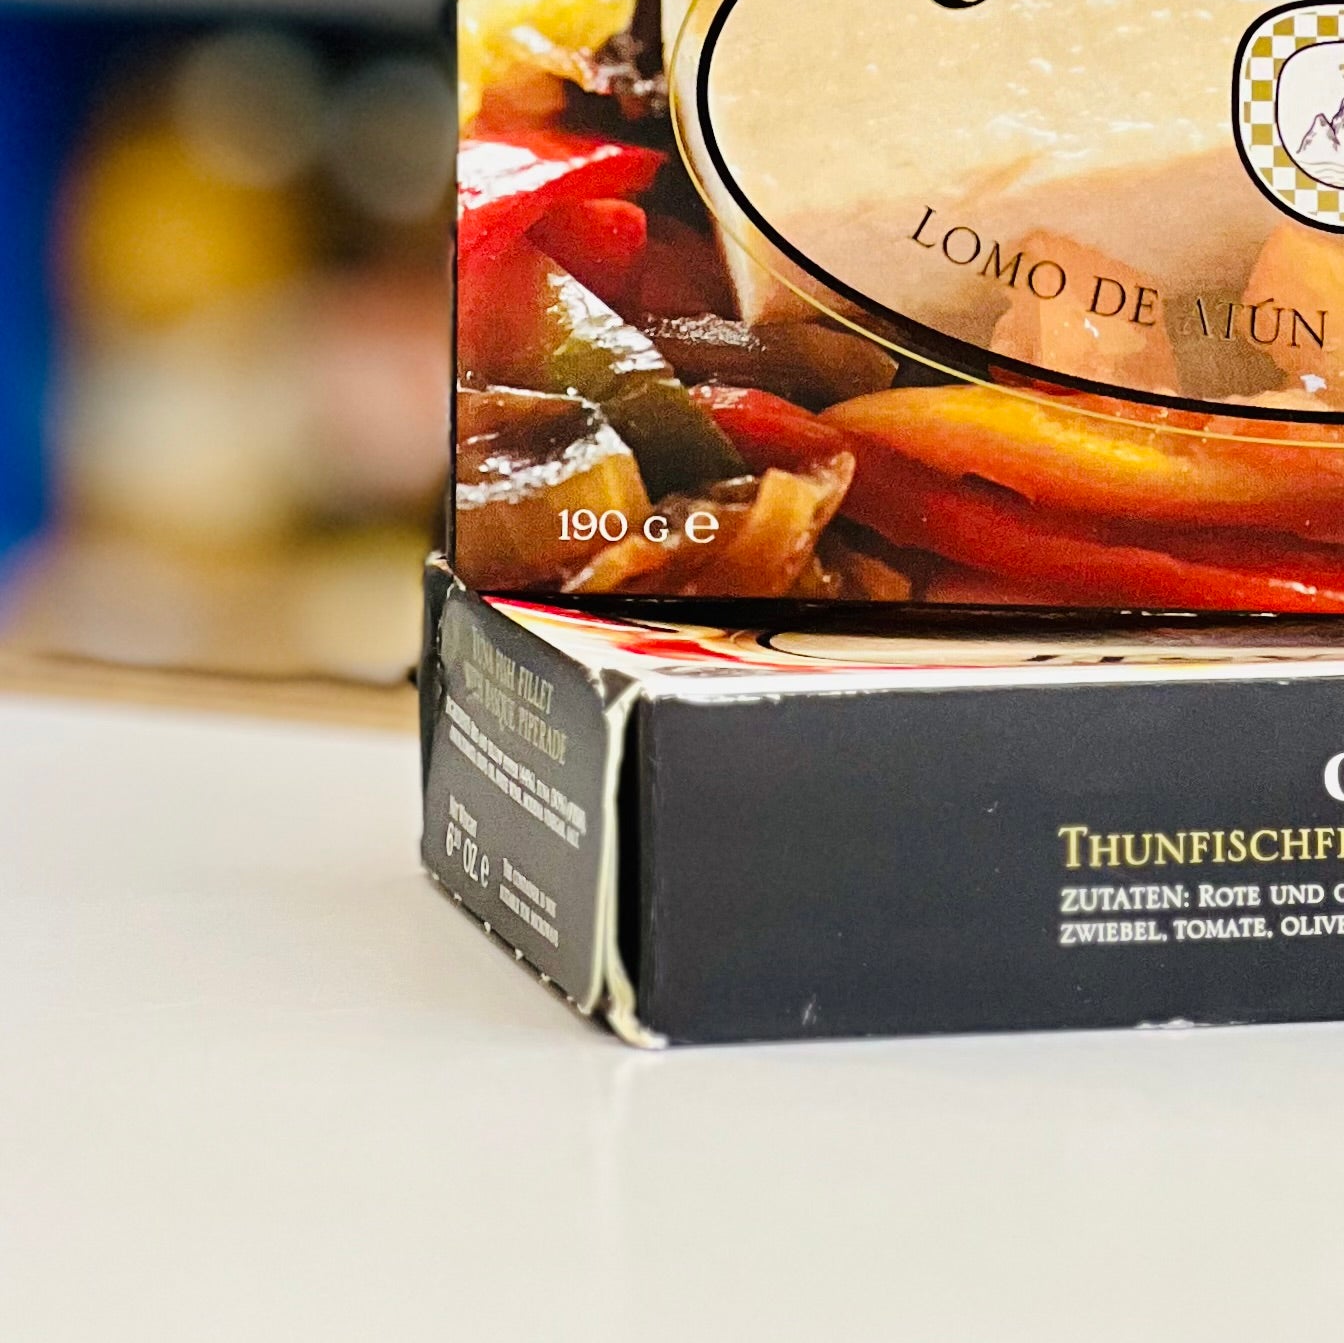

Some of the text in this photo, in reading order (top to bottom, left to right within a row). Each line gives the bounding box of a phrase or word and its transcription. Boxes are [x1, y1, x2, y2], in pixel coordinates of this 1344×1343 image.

[909, 206, 1066, 299] LOMO
[1087, 275, 1158, 326] DE
[558, 508, 628, 542] 190
[643, 515, 669, 543] G
[1059, 885, 1190, 913] ZUTATEN:
[1198, 882, 1259, 908] ROTE
[1270, 882, 1325, 906] UND
[1059, 920, 1168, 945] ZWIEBEL,
[1173, 916, 1273, 941] TOMATE,
